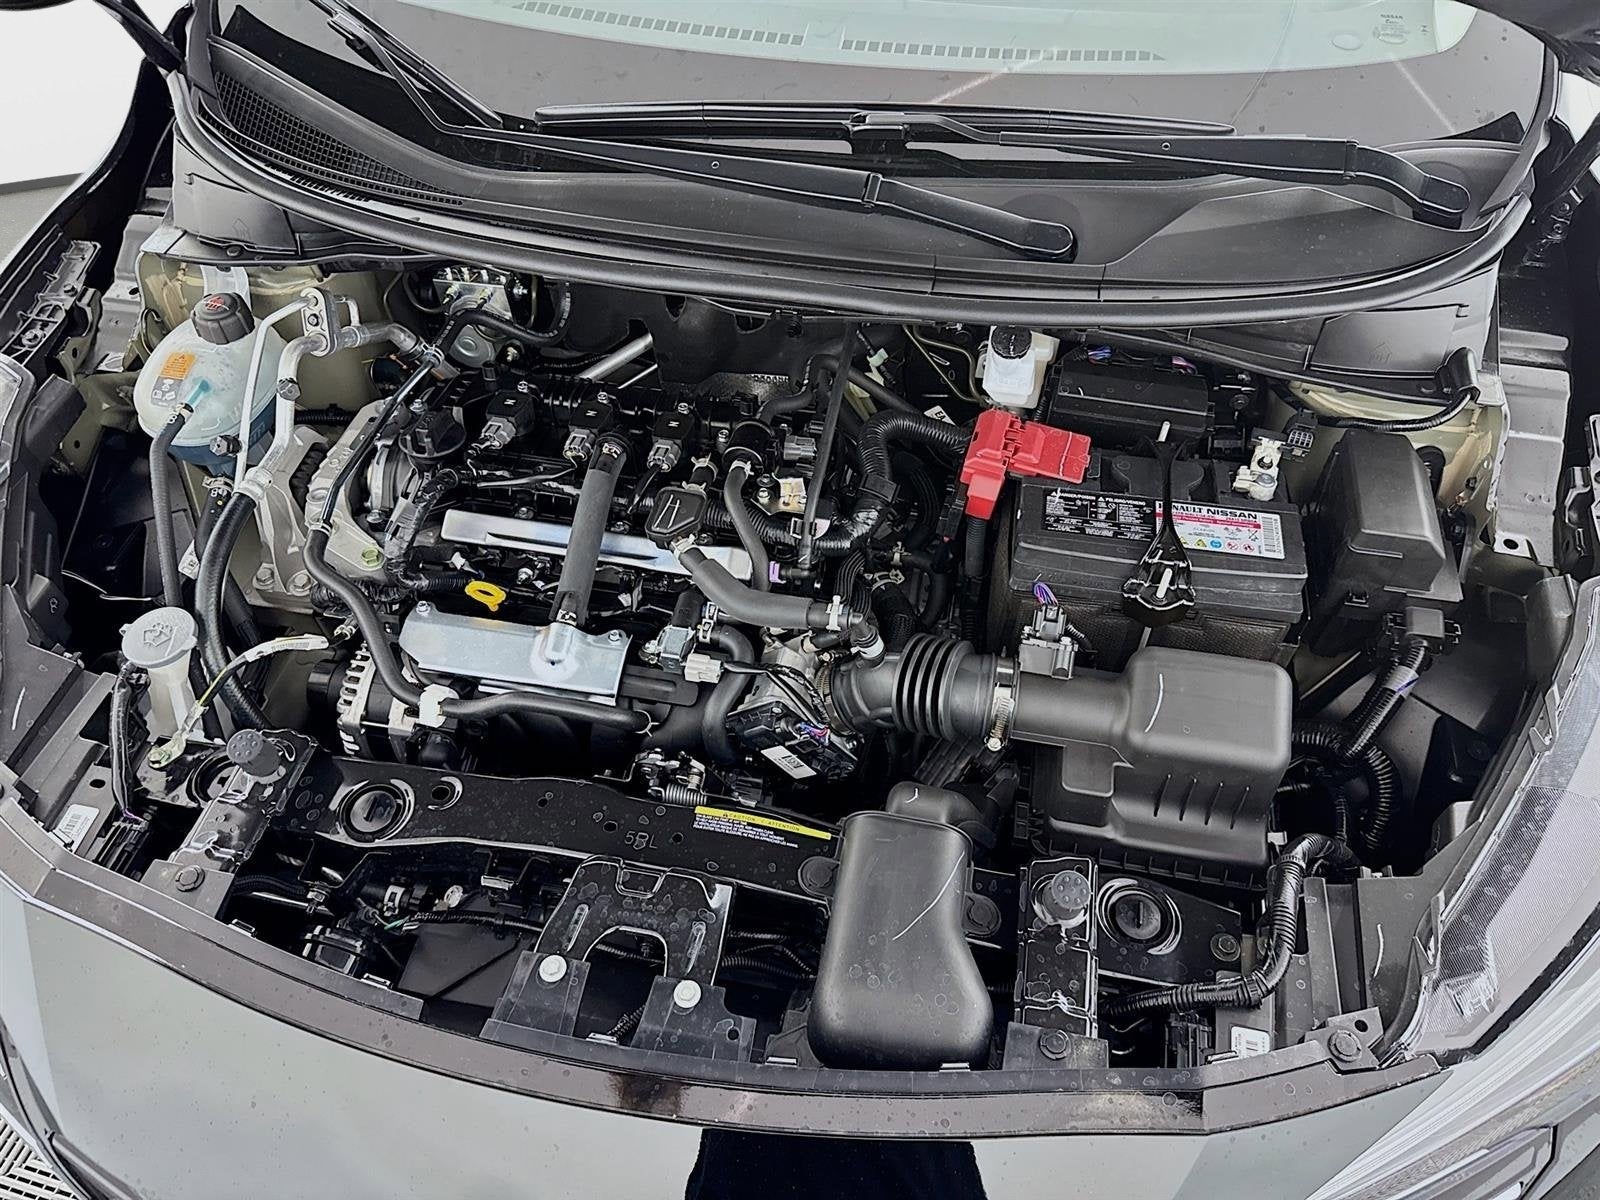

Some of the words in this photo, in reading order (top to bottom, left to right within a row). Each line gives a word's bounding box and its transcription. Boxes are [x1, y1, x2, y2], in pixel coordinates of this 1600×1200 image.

[1206, 508, 1258, 520] NISSAN
[729, 814, 756, 822] CAUTION
[768, 822, 800, 832] ATTENTION
